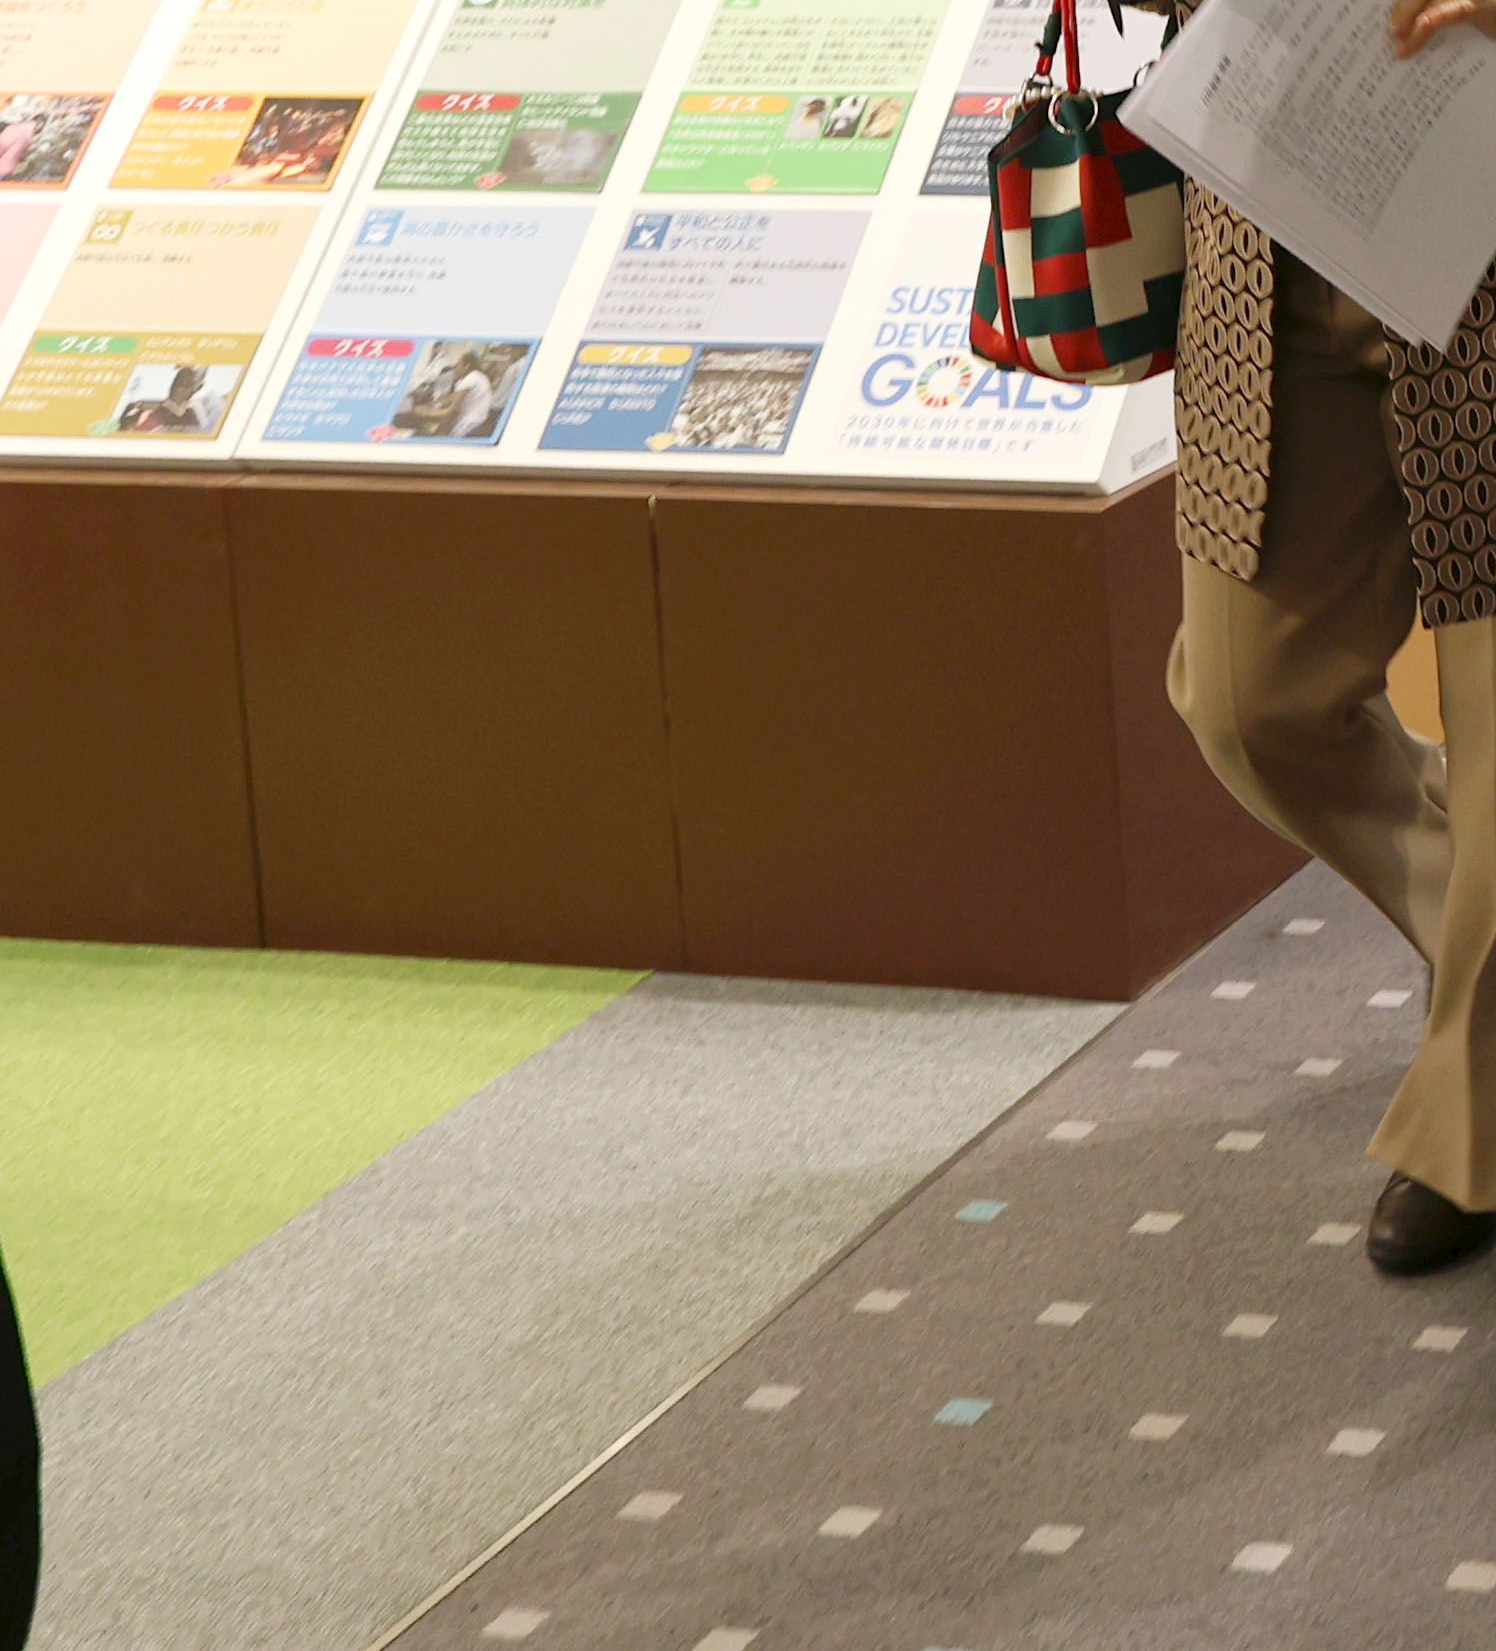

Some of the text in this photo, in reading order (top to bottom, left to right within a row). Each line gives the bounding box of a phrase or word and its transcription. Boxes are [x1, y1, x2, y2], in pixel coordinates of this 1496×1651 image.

[179, 93, 228, 112] クイズ
[440, 93, 496, 112] クイズ
[708, 95, 763, 112] クイズ
[886, 285, 973, 316] SUST
[58, 335, 114, 353] クイズ
[332, 339, 389, 357] クイズ
[608, 346, 664, 364] クイズ
